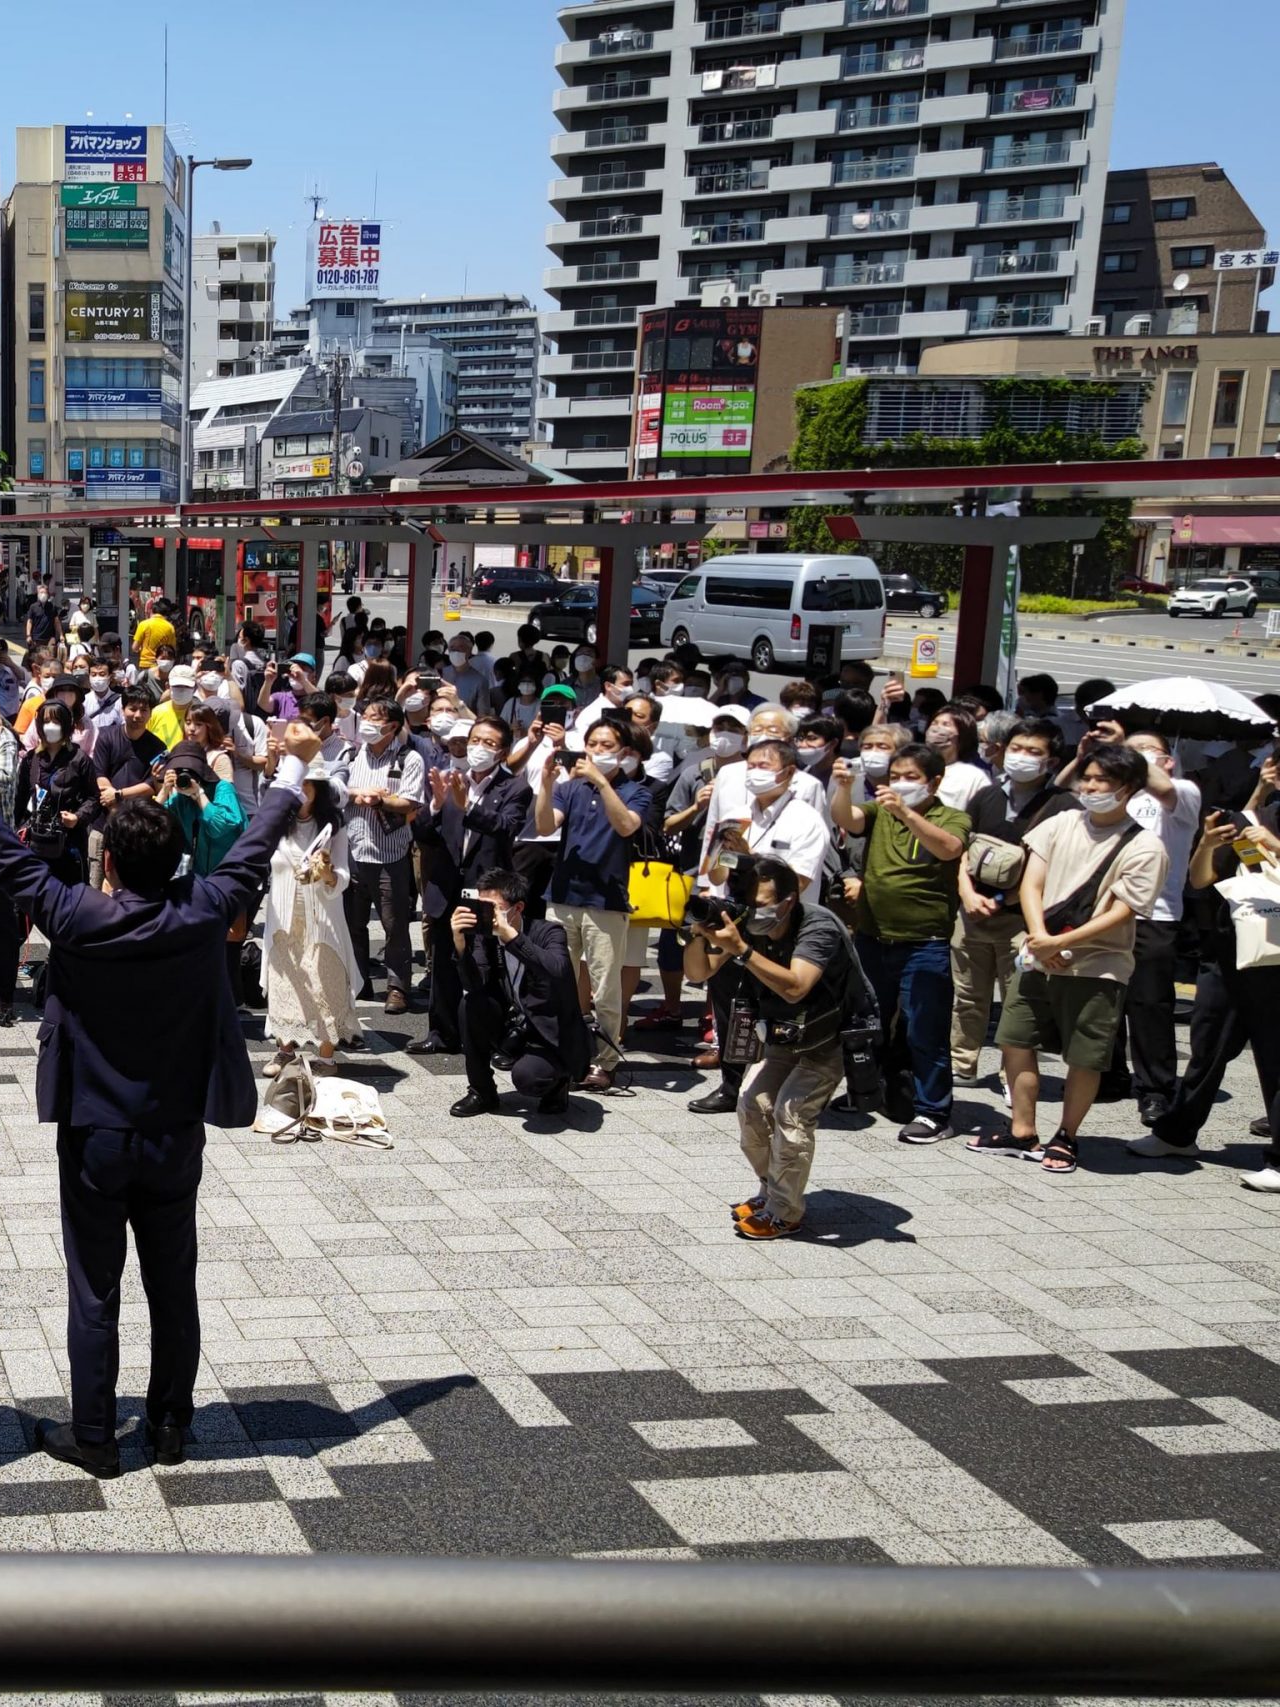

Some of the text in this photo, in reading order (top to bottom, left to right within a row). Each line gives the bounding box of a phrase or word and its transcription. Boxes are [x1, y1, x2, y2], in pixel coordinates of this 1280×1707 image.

[70, 135, 142, 150] アパマンショップ
[78, 186, 120, 205] エイブル
[319, 225, 359, 245] 広告
[318, 247, 380, 267] 募集中
[1219, 251, 1280, 268] 宮本歯
[70, 307, 144, 318] CENTURY 21
[727, 324, 758, 335] GYM
[1094, 345, 1199, 361] THE ANGE
[694, 399, 721, 410] Room
[670, 433, 708, 444] POLUS
[727, 433, 743, 442] 3F
